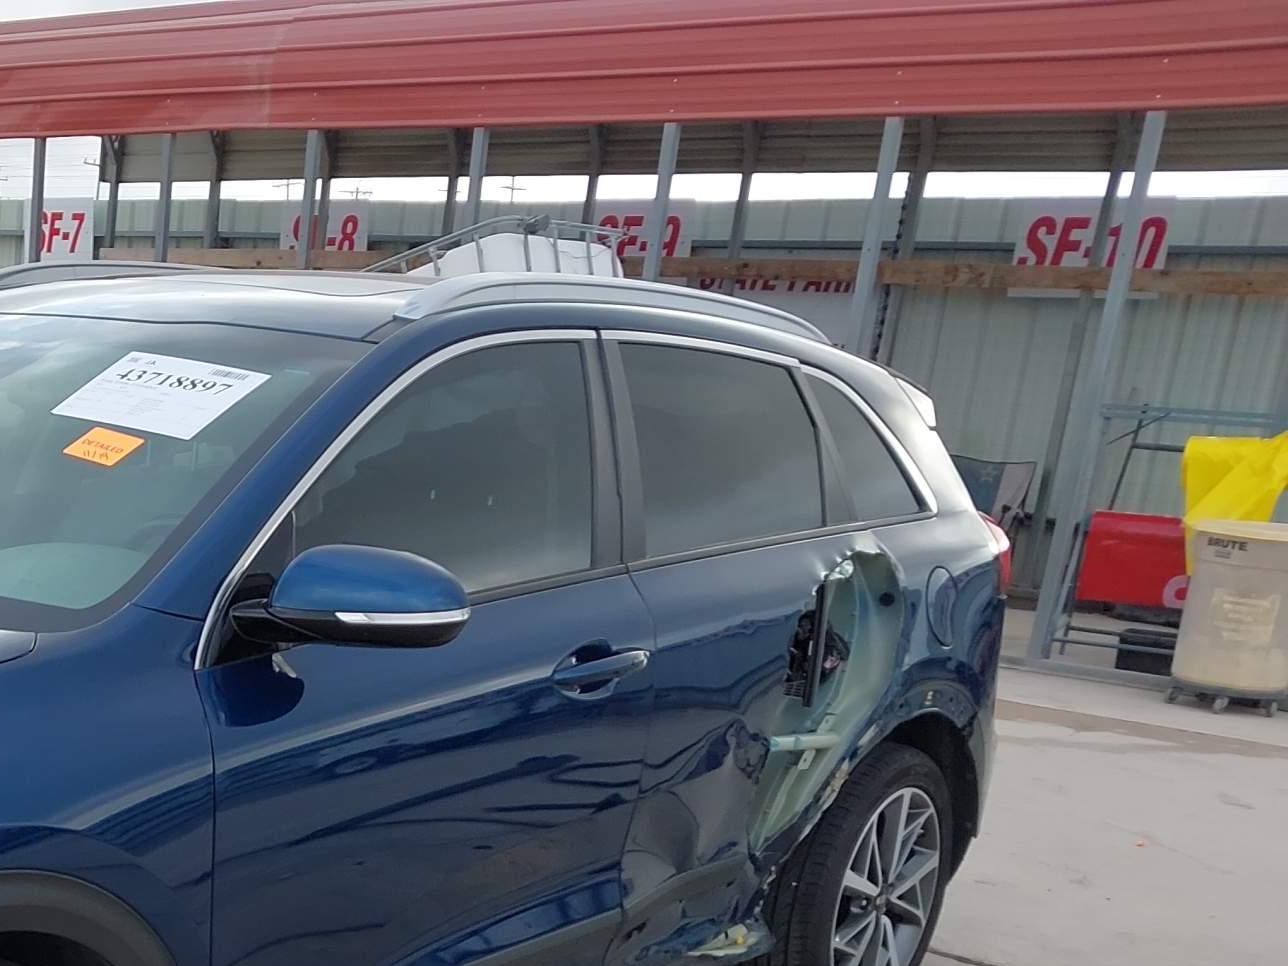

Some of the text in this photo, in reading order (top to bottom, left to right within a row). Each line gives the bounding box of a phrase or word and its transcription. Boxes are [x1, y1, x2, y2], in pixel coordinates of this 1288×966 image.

[289, 214, 358, 250] -8
[1016, 216, 1168, 268] SF-10
[115, 368, 233, 395] 43718897
[1207, 536, 1249, 552] BRUTE
